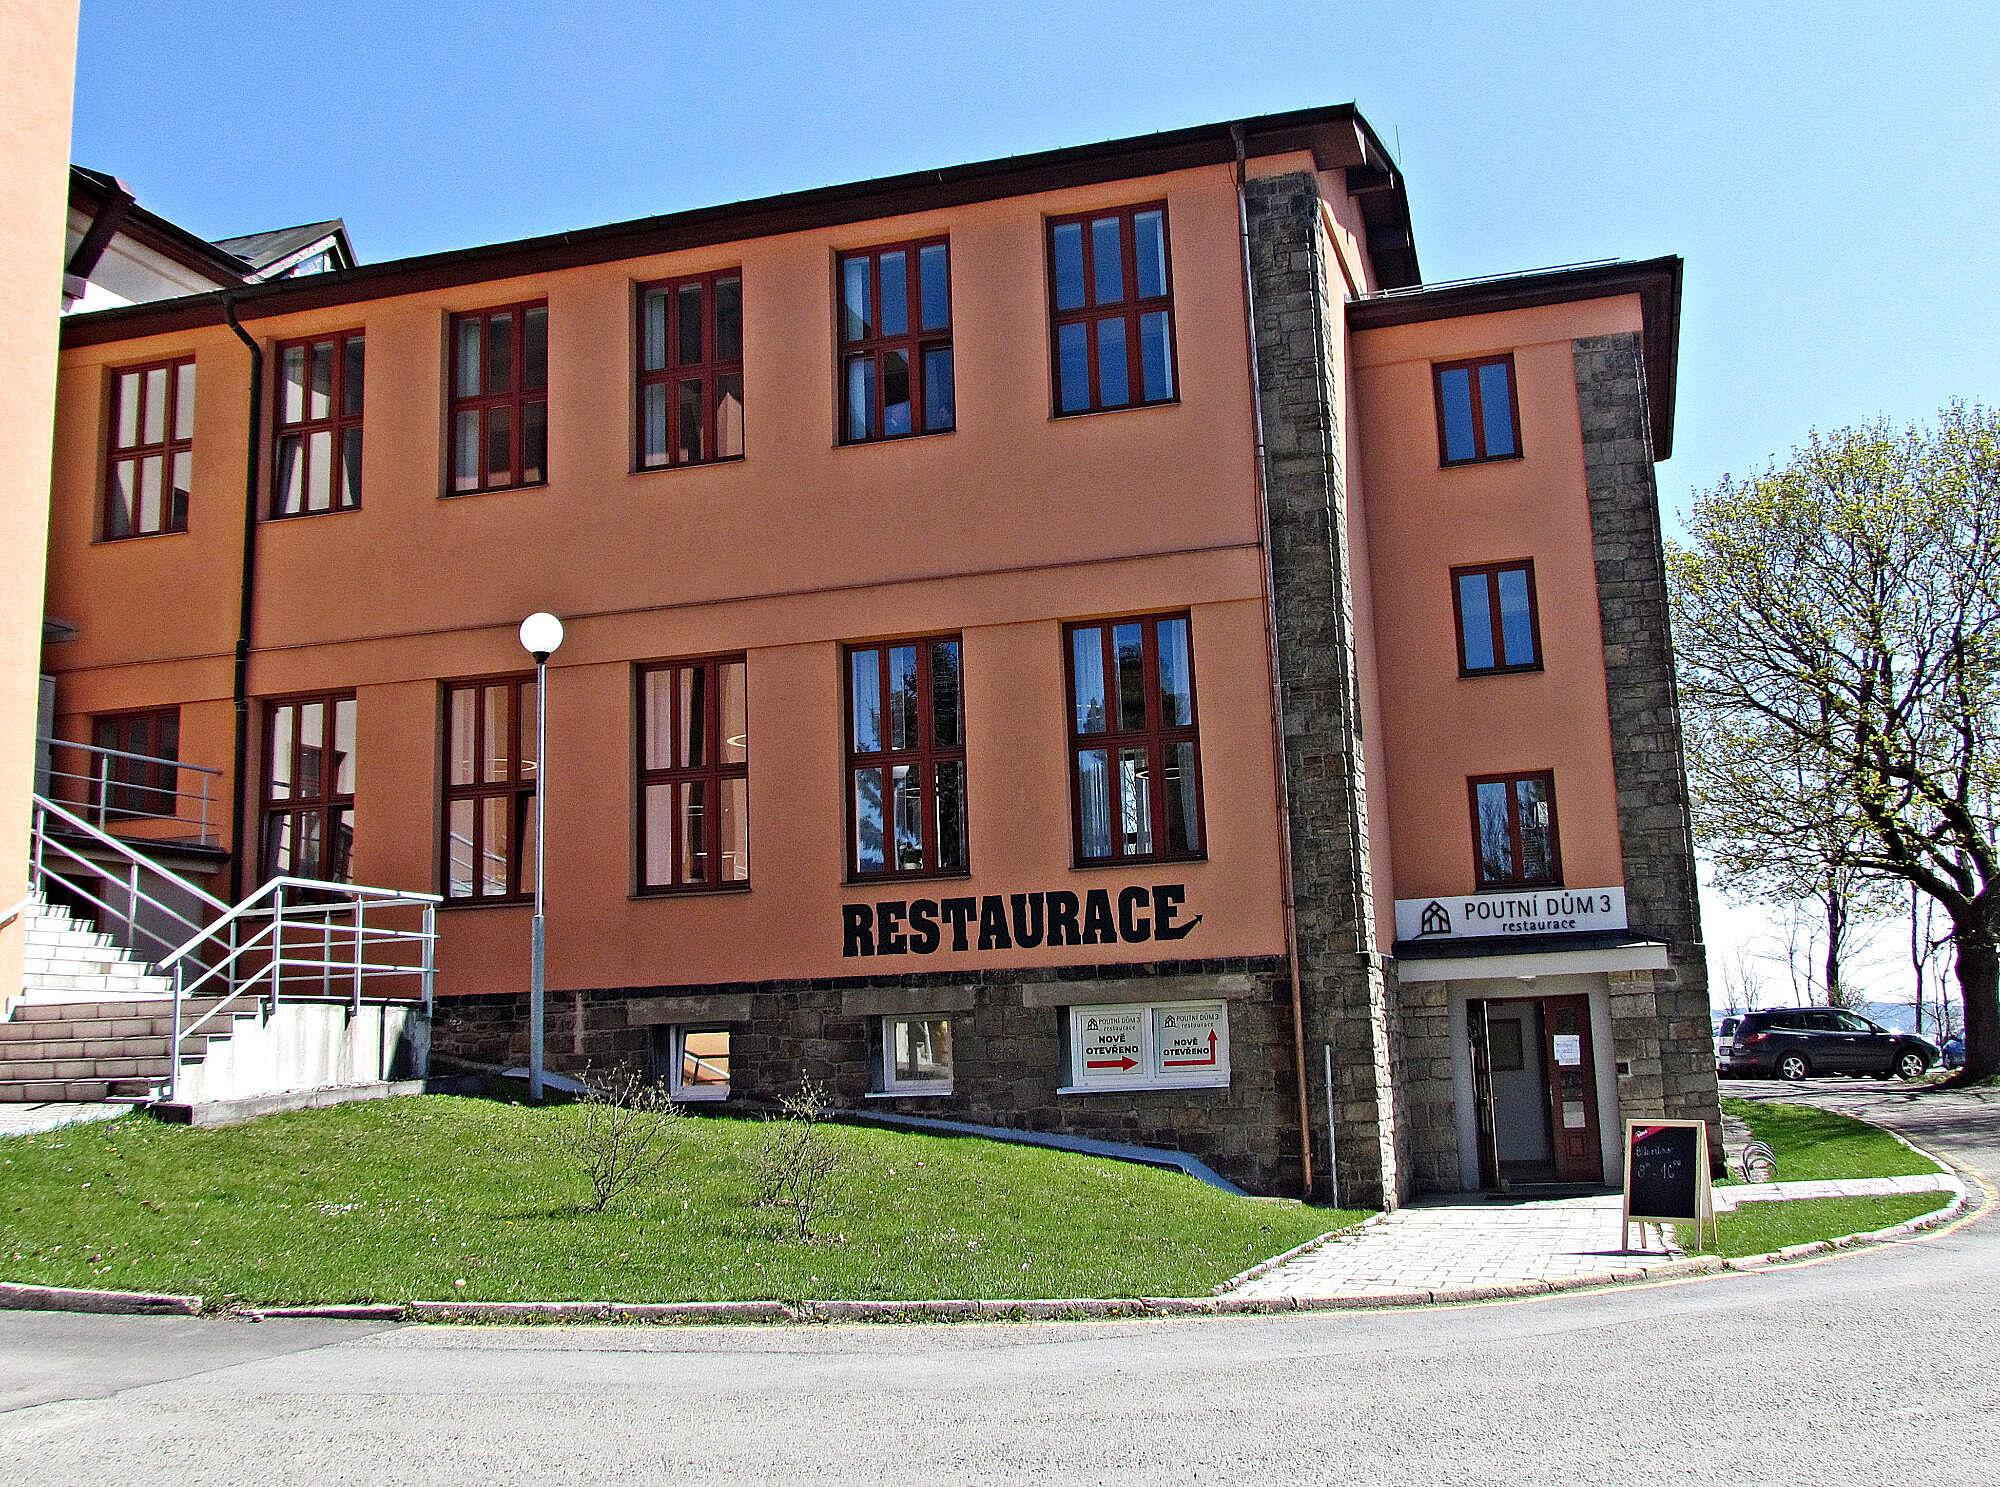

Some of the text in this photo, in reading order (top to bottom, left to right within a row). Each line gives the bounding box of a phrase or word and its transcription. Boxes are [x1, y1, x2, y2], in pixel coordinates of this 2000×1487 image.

[1464, 892, 1612, 920] POUTNÍ DŮM 3
[842, 884, 1187, 957] RESTAURACE
[1502, 918, 1576, 932] restaurace
[1098, 1033, 1126, 1044] NOVĚ
[1086, 1044, 1139, 1055] OTEVŘENO
[1163, 1046, 1209, 1056] OTEVŘENO
